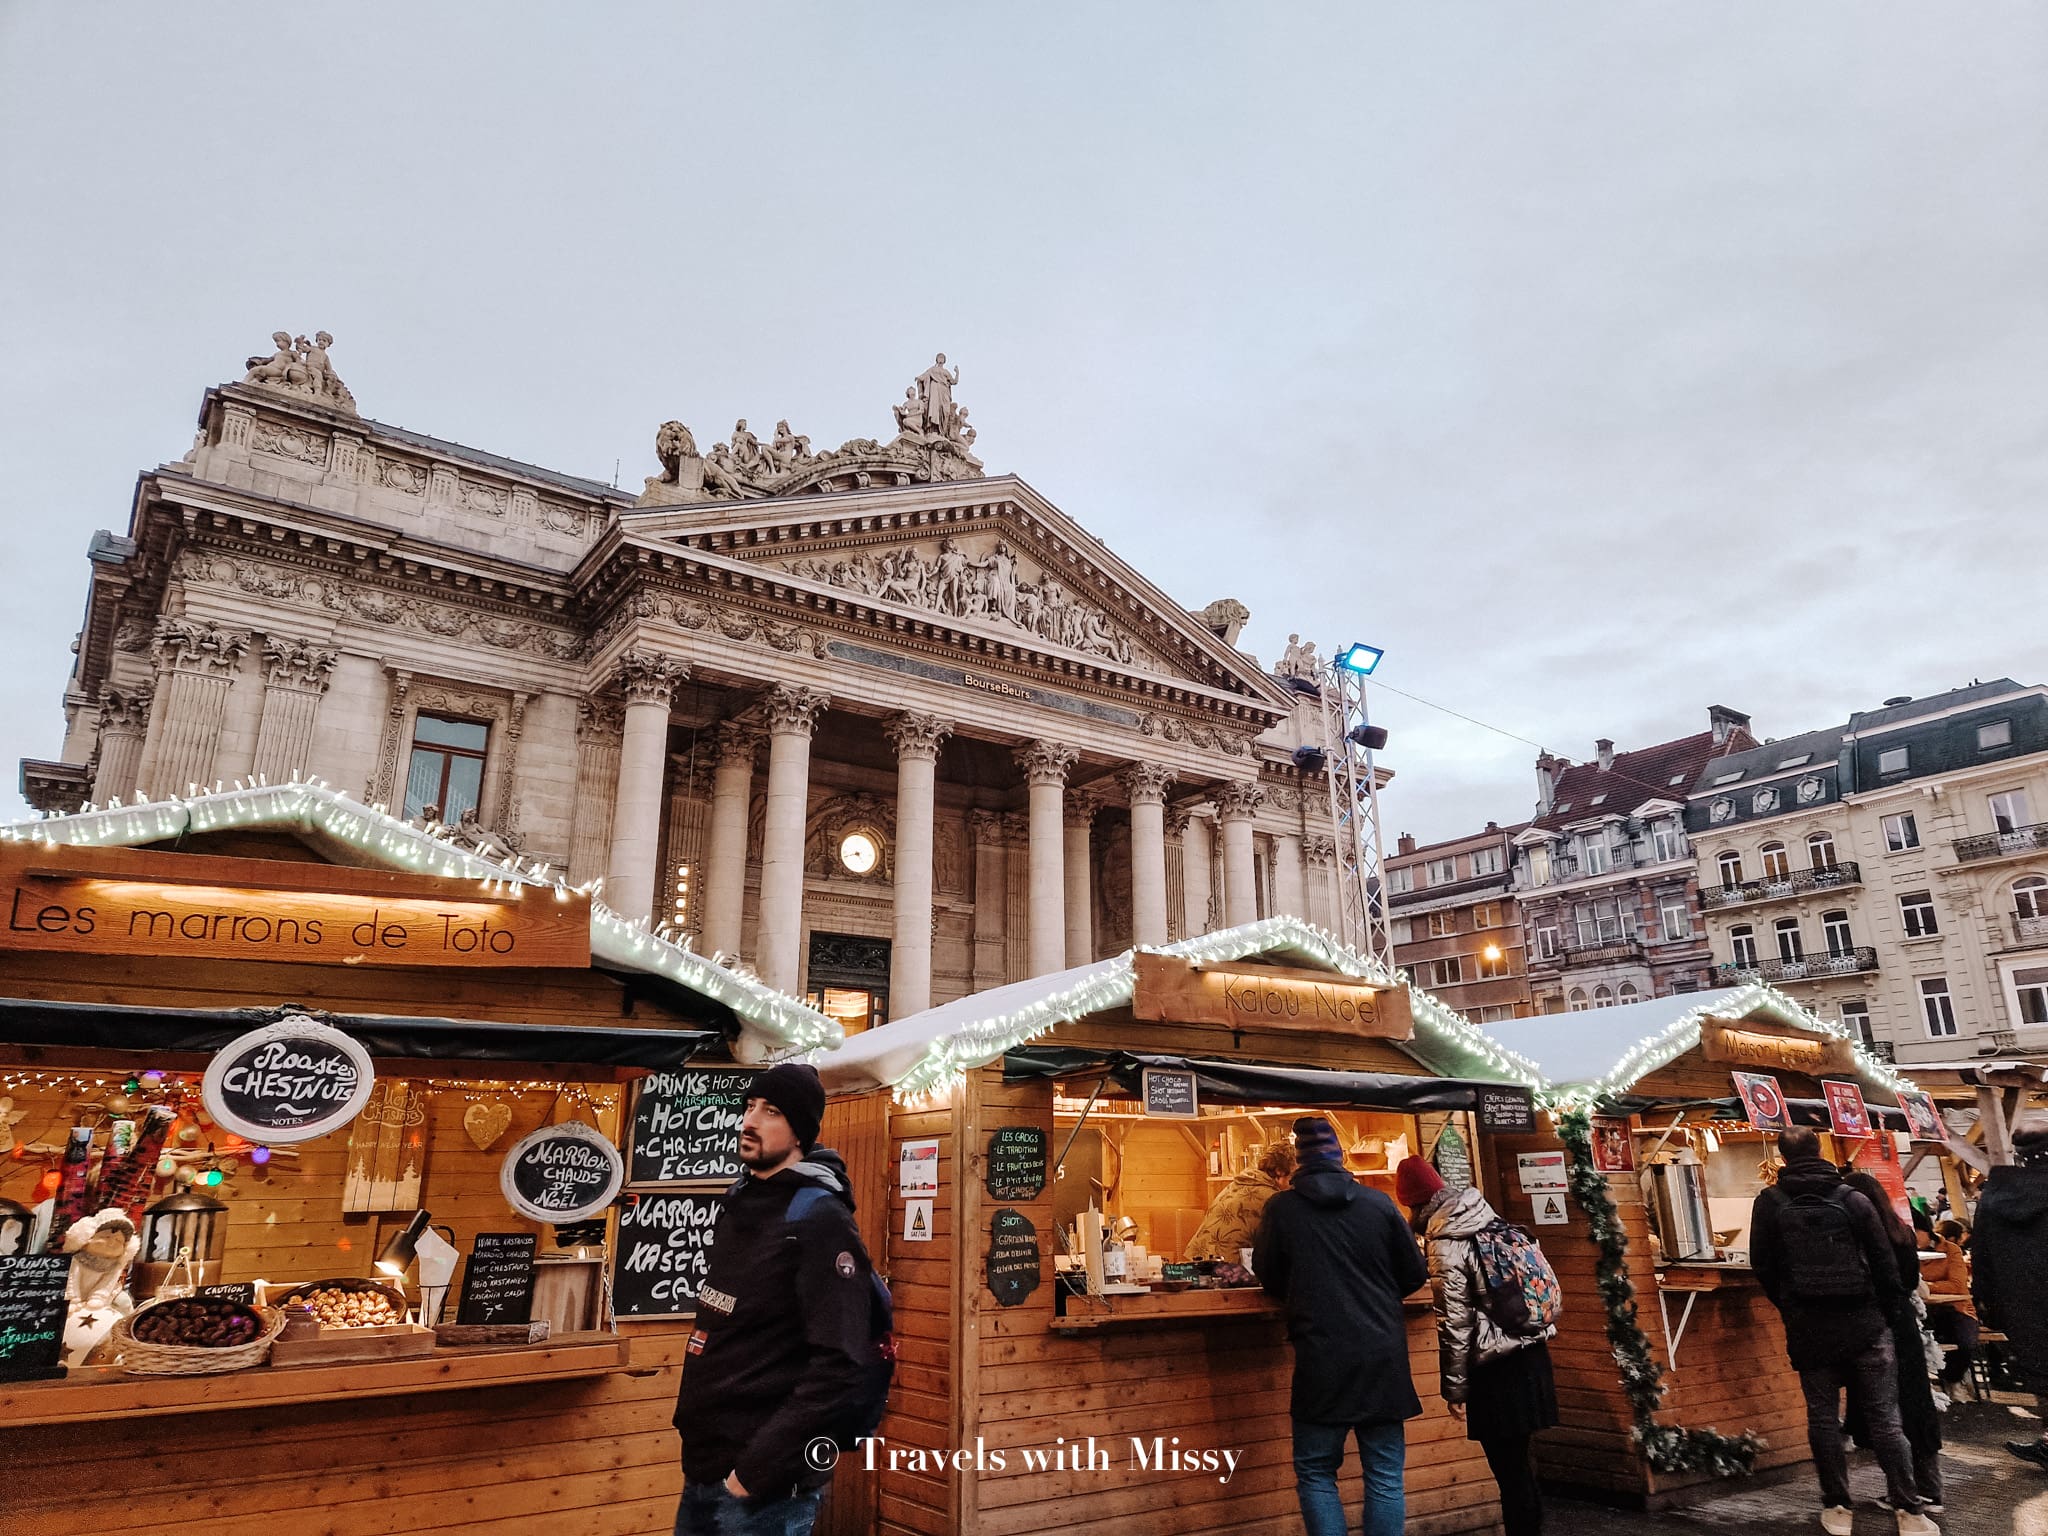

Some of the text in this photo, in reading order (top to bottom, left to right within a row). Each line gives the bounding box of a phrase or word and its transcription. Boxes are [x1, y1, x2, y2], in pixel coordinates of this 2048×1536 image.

[965, 674, 1030, 699] BourseBeurs
[9, 887, 515, 954] Les marrons de Toto
[1223, 974, 1300, 1017] Kalou
[1725, 1032, 1770, 1058] Maison
[712, 1075, 739, 1090] HOT
[271, 1116, 304, 1127] NOTES
[650, 1103, 700, 1134] HOT
[1001, 1132, 1039, 1143] LES GROGS
[525, 1142, 611, 1171] MARRONS
[996, 1146, 1038, 1155] LE TRADITION
[996, 1162, 1005, 1172] LE
[543, 1168, 602, 1184] CHAUDS
[549, 1182, 576, 1195] DE
[473, 1263, 530, 1274] HOT CHESTNUTS
